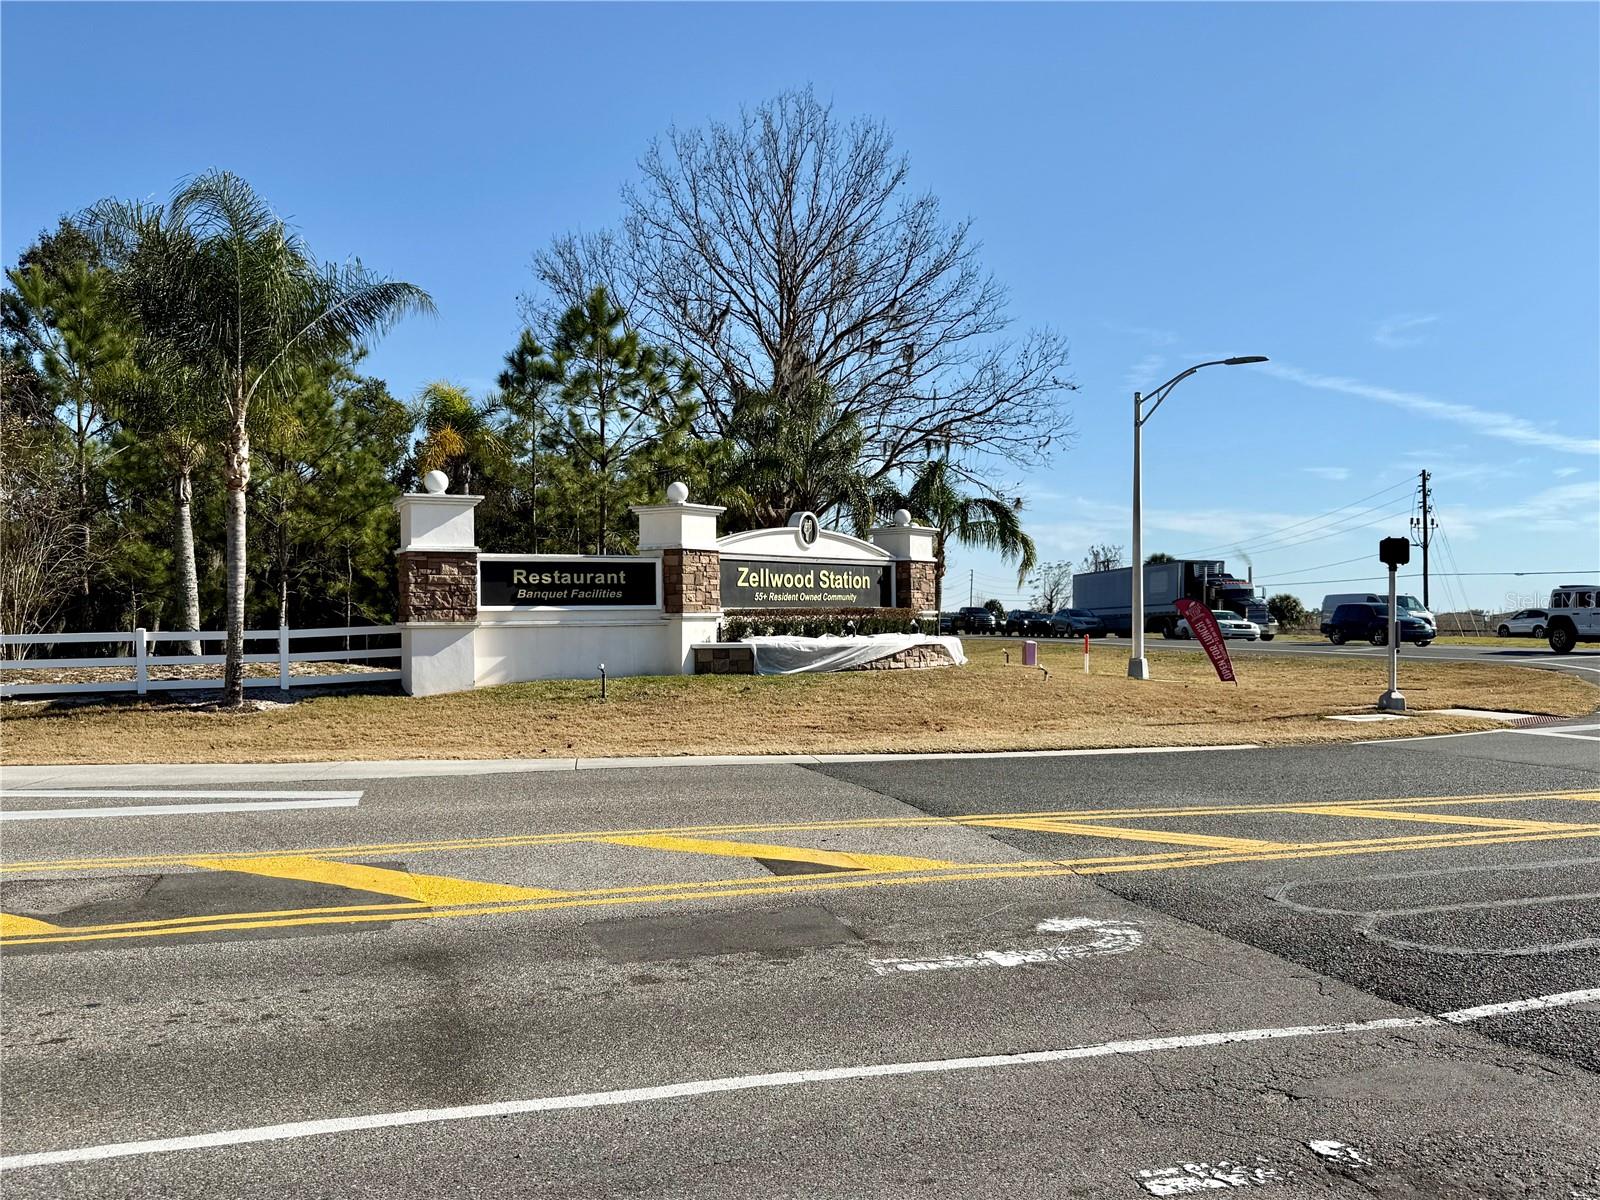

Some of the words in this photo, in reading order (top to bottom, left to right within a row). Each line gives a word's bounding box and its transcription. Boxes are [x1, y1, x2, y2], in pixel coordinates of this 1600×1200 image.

[513, 569, 626, 584] Restaurant
[736, 567, 814, 588] Zellwood
[819, 569, 871, 589] Station
[517, 589, 567, 600] Banquet
[571, 589, 622, 598] Facilities
[754, 592, 768, 601] 55+
[768, 592, 799, 601] Resident
[799, 592, 822, 601] Owned
[822, 592, 857, 603] Community
[1195, 621, 1215, 646] LUNCH
[1209, 644, 1222, 660] FOR
[1217, 659, 1232, 680] OPEN
